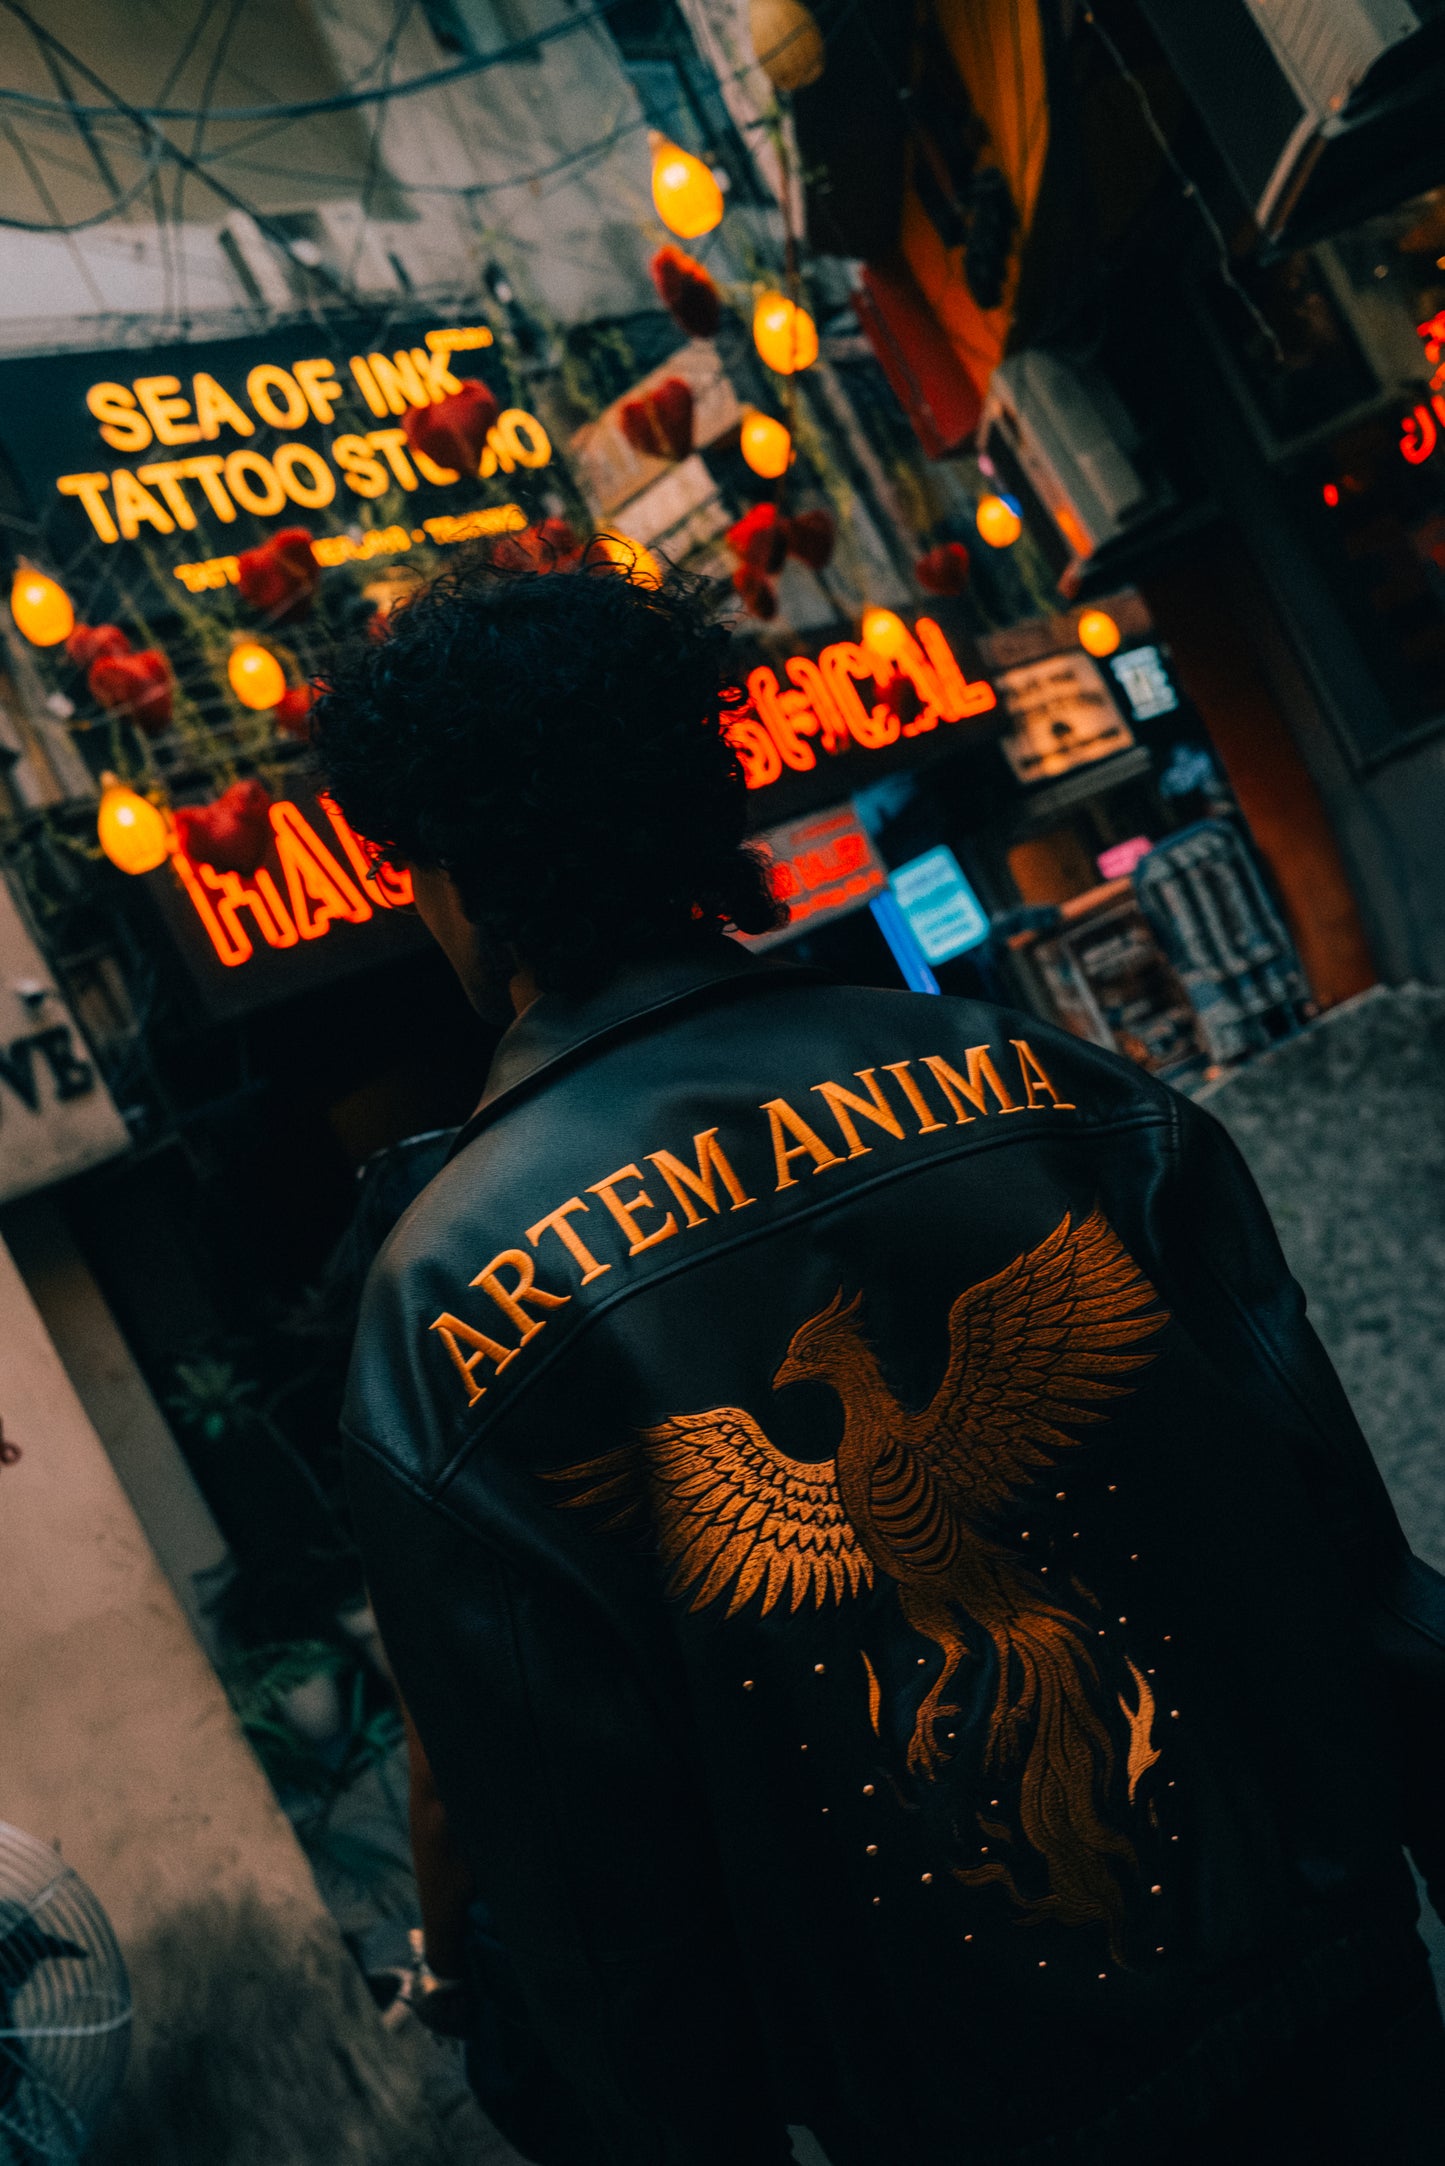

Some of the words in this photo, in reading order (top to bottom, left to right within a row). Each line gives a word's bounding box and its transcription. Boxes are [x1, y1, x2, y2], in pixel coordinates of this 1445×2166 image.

[87, 372, 256, 452] SEA
[247, 358, 343, 430] OF
[350, 345, 464, 418] INK
[57, 443, 336, 543] TATTOO
[332, 408, 552, 498] STIO
[429, 1127, 757, 1407] ARTEM
[759, 1039, 1076, 1191] ANIMA
